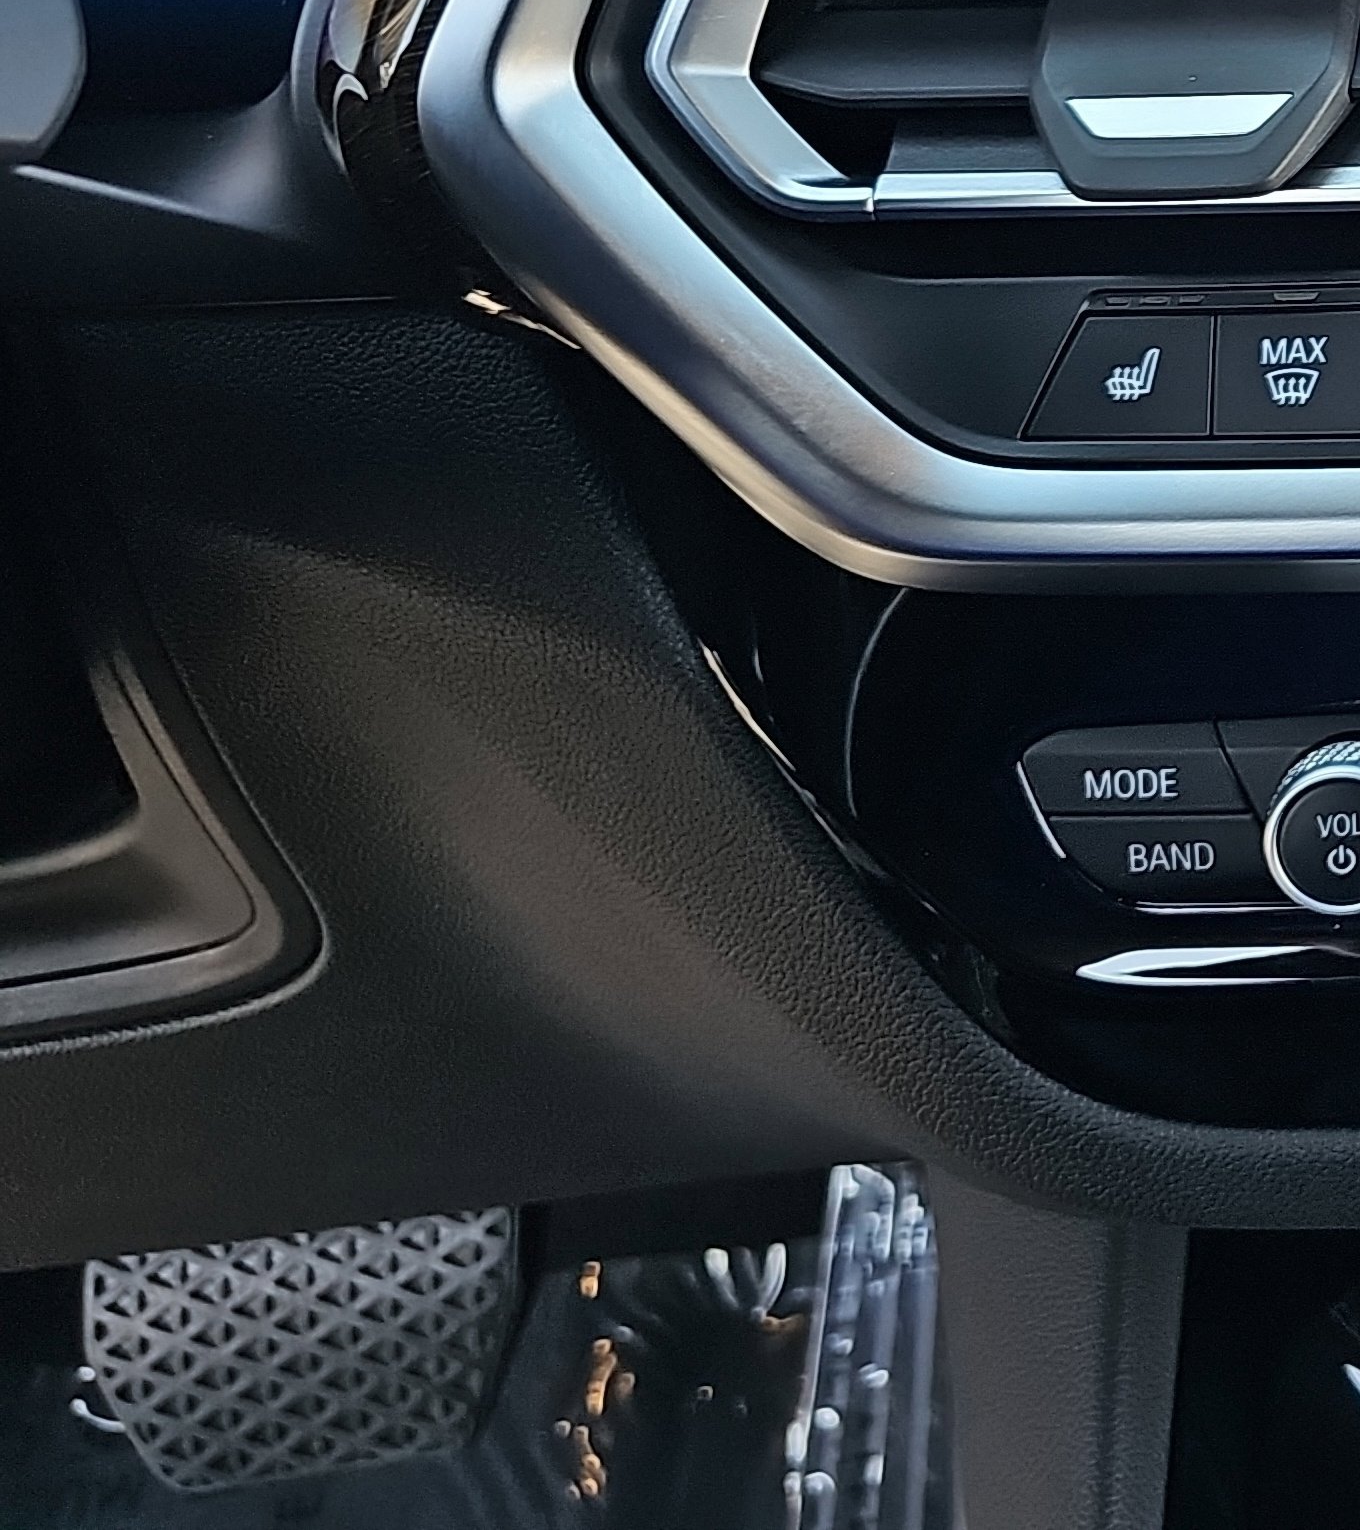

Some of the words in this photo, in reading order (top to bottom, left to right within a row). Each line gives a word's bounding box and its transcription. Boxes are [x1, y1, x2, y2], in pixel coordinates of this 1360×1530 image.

[1261, 337, 1329, 365] MAX
[1084, 768, 1180, 800] MODE
[1128, 842, 1215, 872] BAND
